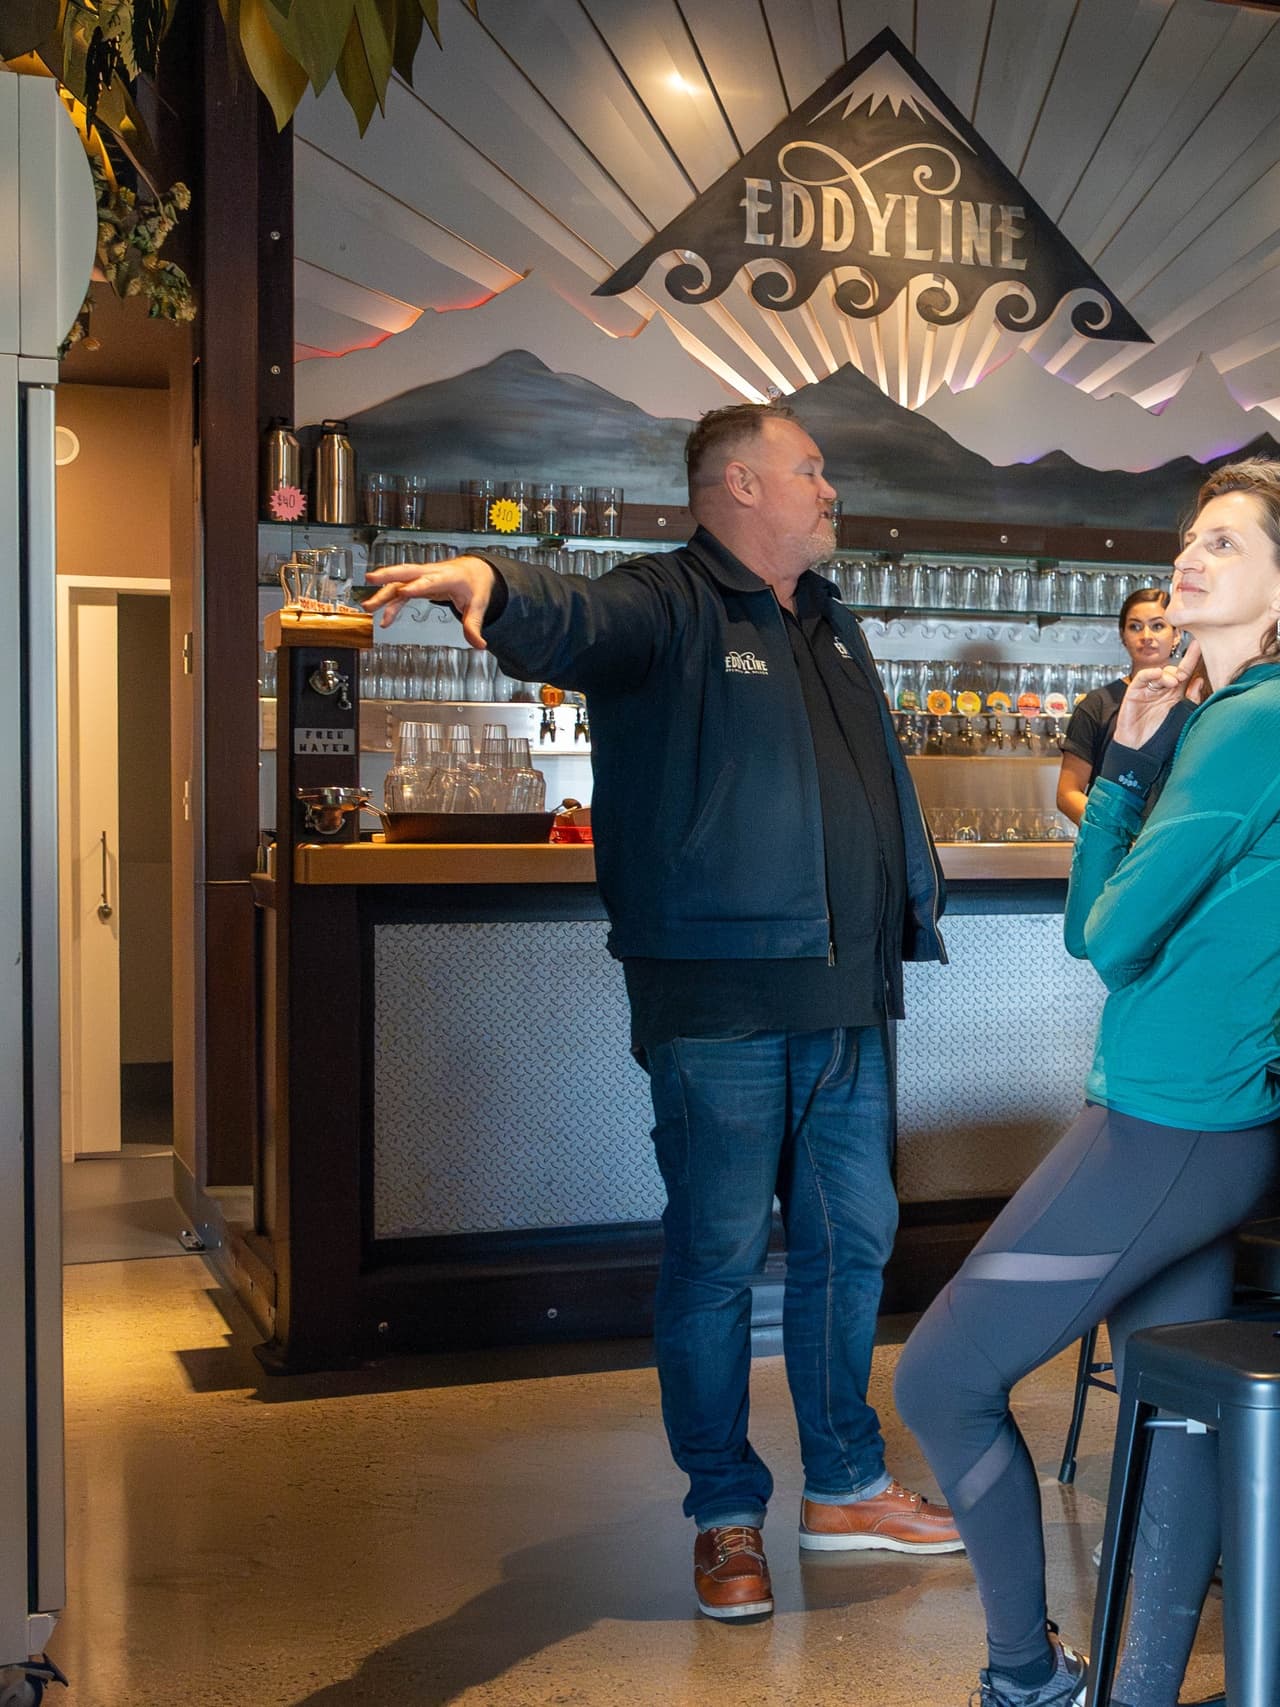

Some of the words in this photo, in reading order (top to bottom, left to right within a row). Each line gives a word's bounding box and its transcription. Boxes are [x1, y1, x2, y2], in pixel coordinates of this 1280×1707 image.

[738, 140, 1028, 271] EDDYLINE
[276, 494, 296, 509] $40
[496, 507, 513, 521] $10
[724, 651, 768, 671] EDDYLINE
[305, 730, 344, 739] FREE
[299, 743, 350, 752] WATER
